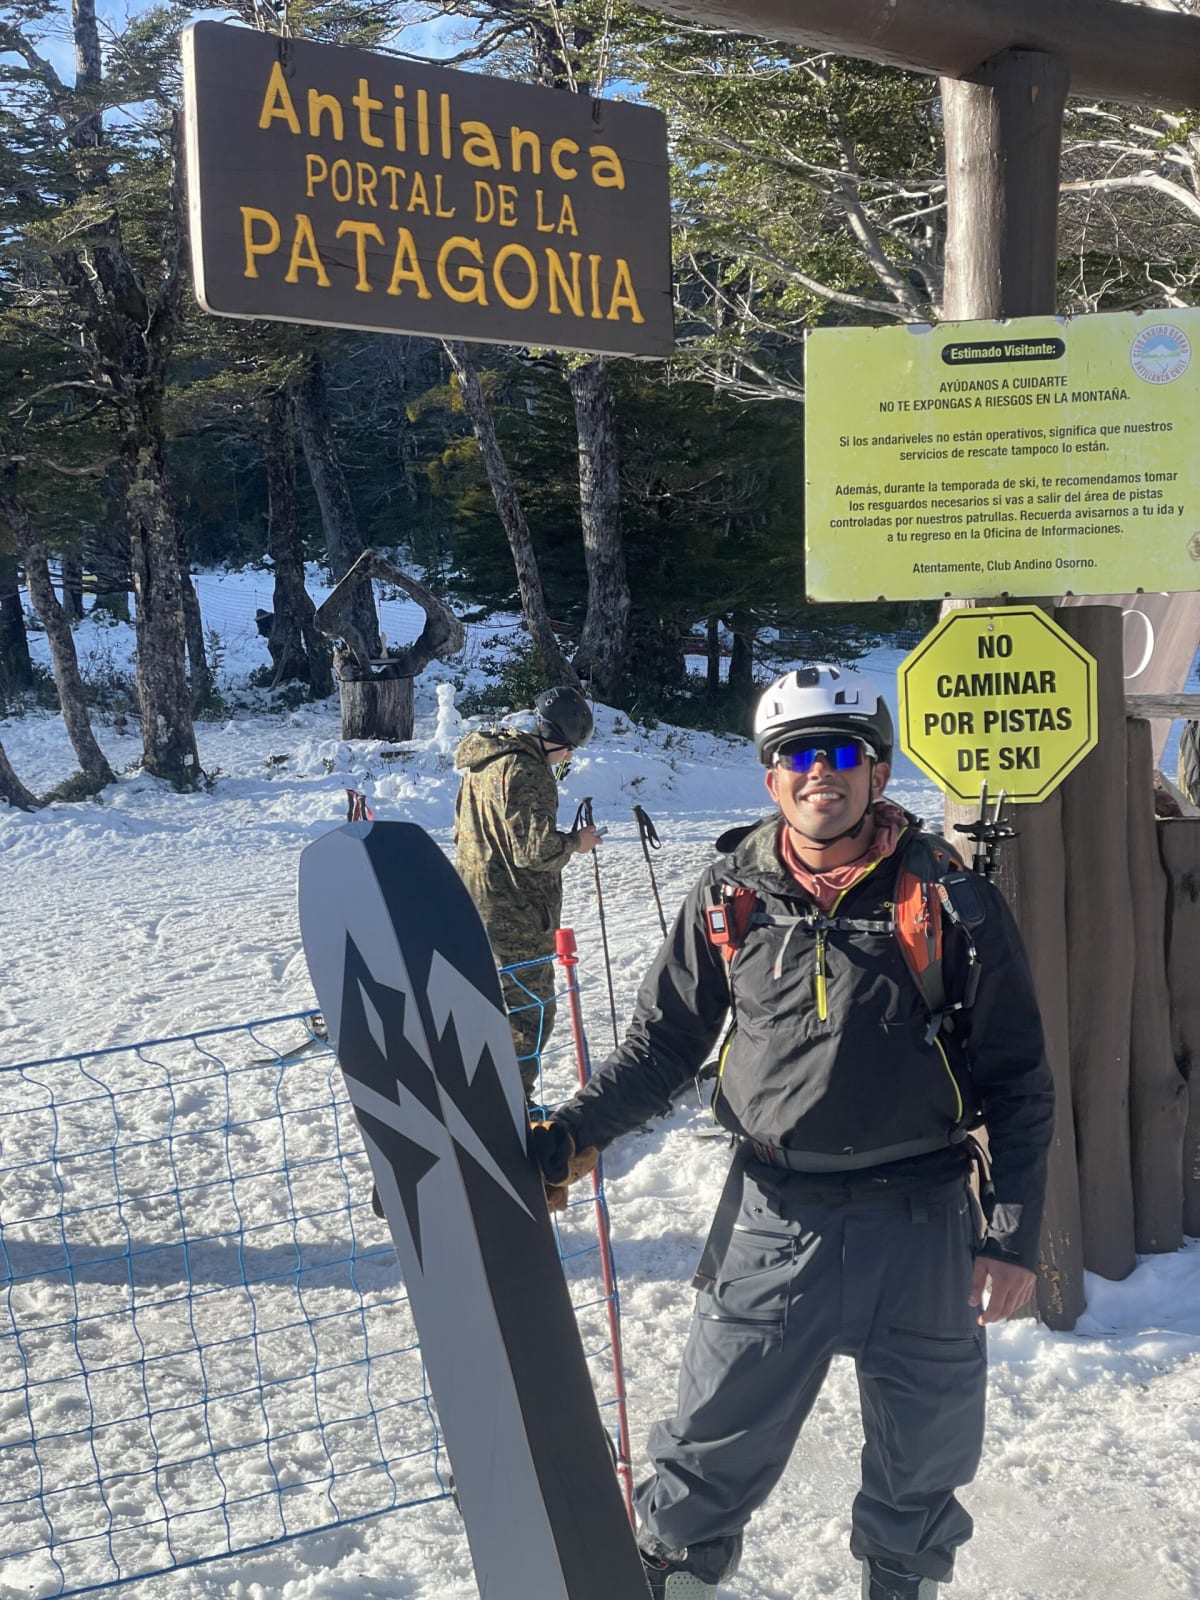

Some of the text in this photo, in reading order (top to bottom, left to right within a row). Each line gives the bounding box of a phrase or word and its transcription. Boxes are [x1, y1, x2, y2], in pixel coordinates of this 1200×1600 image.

[258, 60, 626, 191] Antillanca
[305, 153, 579, 236] PORTAL DE LA
[240, 206, 645, 324] PATAGONIA
[951, 343, 1056, 359] Estimado Visitante:
[940, 376, 1068, 393] AYÚDANOS A CUIDARTE
[879, 388, 1130, 412] NO TE EXPONGAS A RIESGOS EN LA MONTAÑA.
[839, 421, 1173, 447] Si los andariveles no están operativos, significa que nuestros
[900, 441, 1109, 461] servicios de rescate tampoco lo están.
[835, 471, 1178, 496] Además, durante la temporada de ski, te recomendamos tomar
[849, 489, 1163, 512] los resguardos necesarios si vas a salir del área de pistas
[830, 503, 1184, 528] controladas por nuestros patrullas. Recuerda avisarnos a tu ida y
[887, 524, 1123, 543] a tu regreso en la Oficina de Informaciones.
[913, 558, 1097, 573] Atentamente, Club Andino Osorno.
[977, 634, 1013, 660] NO
[936, 670, 1057, 698] CAMINAR
[924, 706, 1072, 736] POR PISTAS
[957, 746, 1040, 772] DE SKI
